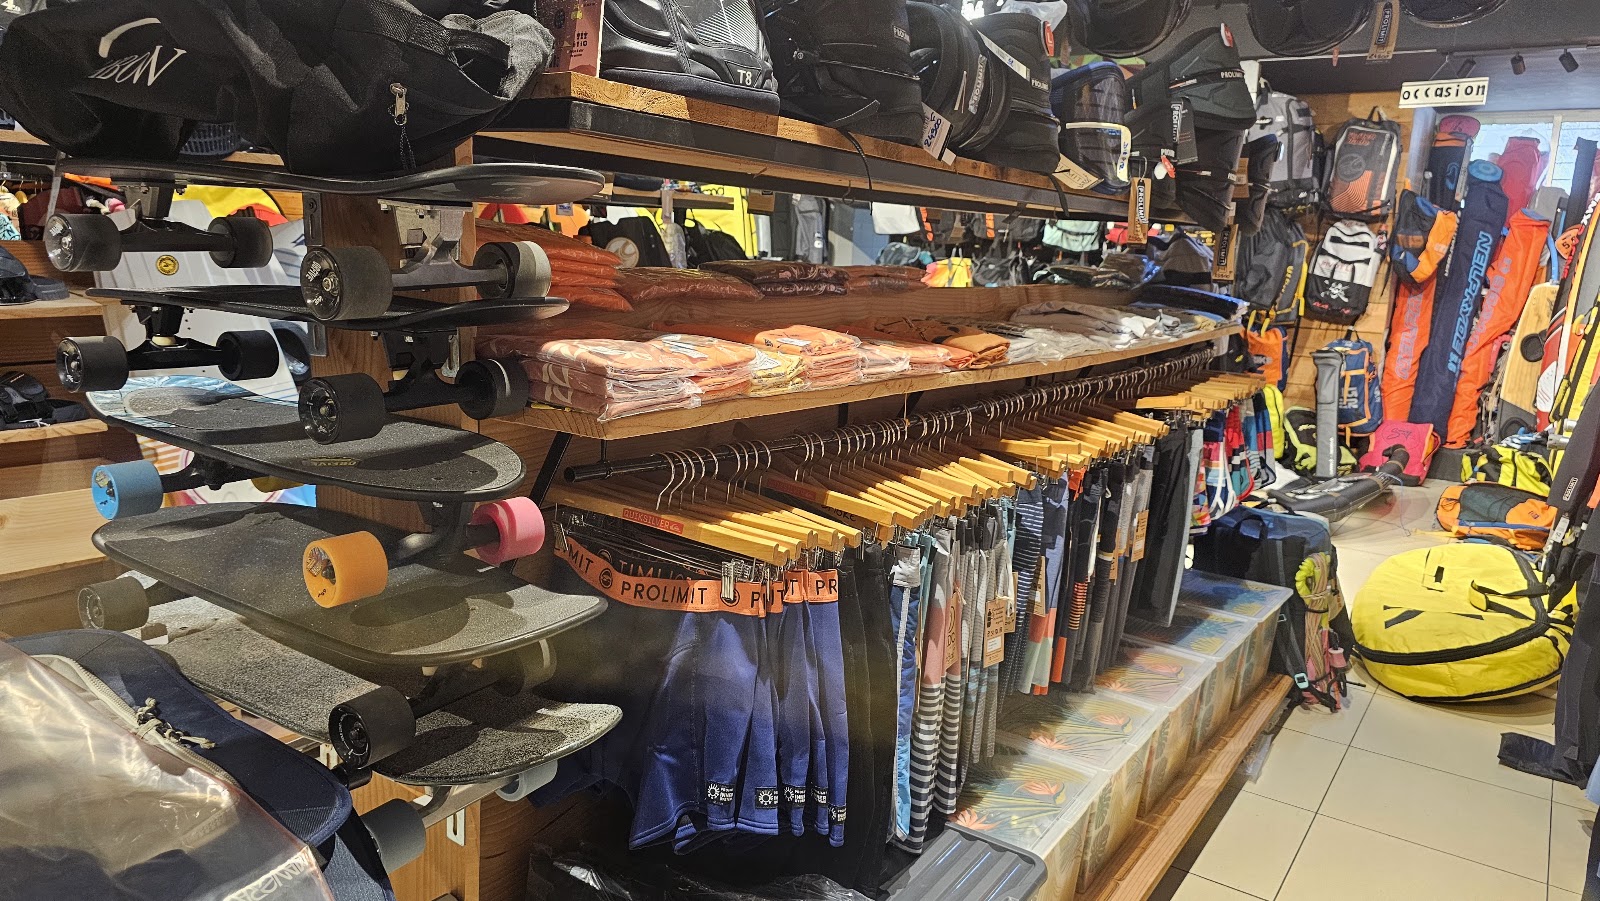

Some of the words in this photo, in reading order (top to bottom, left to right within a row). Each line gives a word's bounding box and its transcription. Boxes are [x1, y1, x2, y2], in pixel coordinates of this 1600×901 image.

[737, 69, 752, 86] T8
[1402, 84, 1486, 100] occasion
[1452, 231, 1493, 355] NEILPRYDE
[624, 509, 670, 530] QUIKSILVER
[621, 580, 708, 605] PROLIMIT
